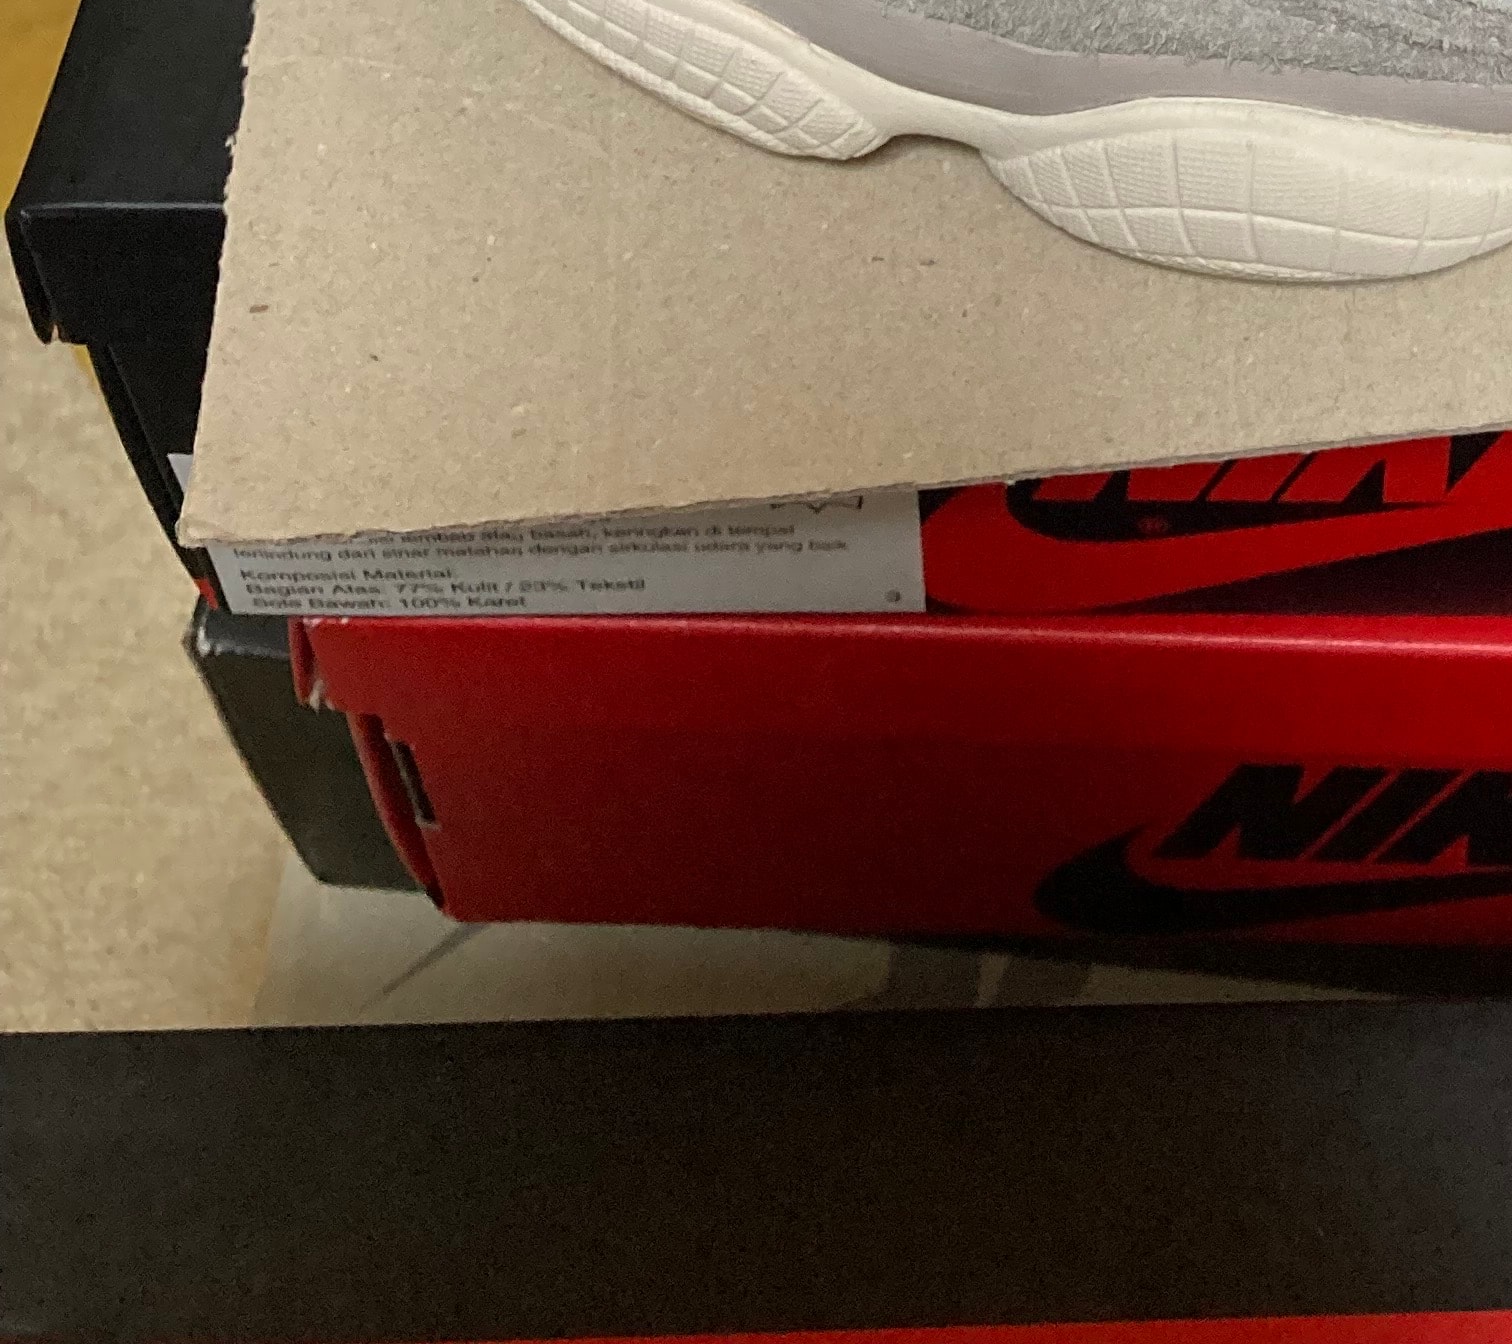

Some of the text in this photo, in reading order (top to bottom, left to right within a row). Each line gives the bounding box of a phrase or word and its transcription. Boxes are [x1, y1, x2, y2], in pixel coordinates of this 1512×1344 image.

[239, 568, 357, 583] Komposisi
[245, 583, 324, 596] Bagian
[395, 582, 443, 593] 77%
[450, 580, 498, 593] Kulit
[575, 579, 646, 592] Tekstil
[399, 597, 461, 609] 100%
[466, 596, 526, 608] Karet
